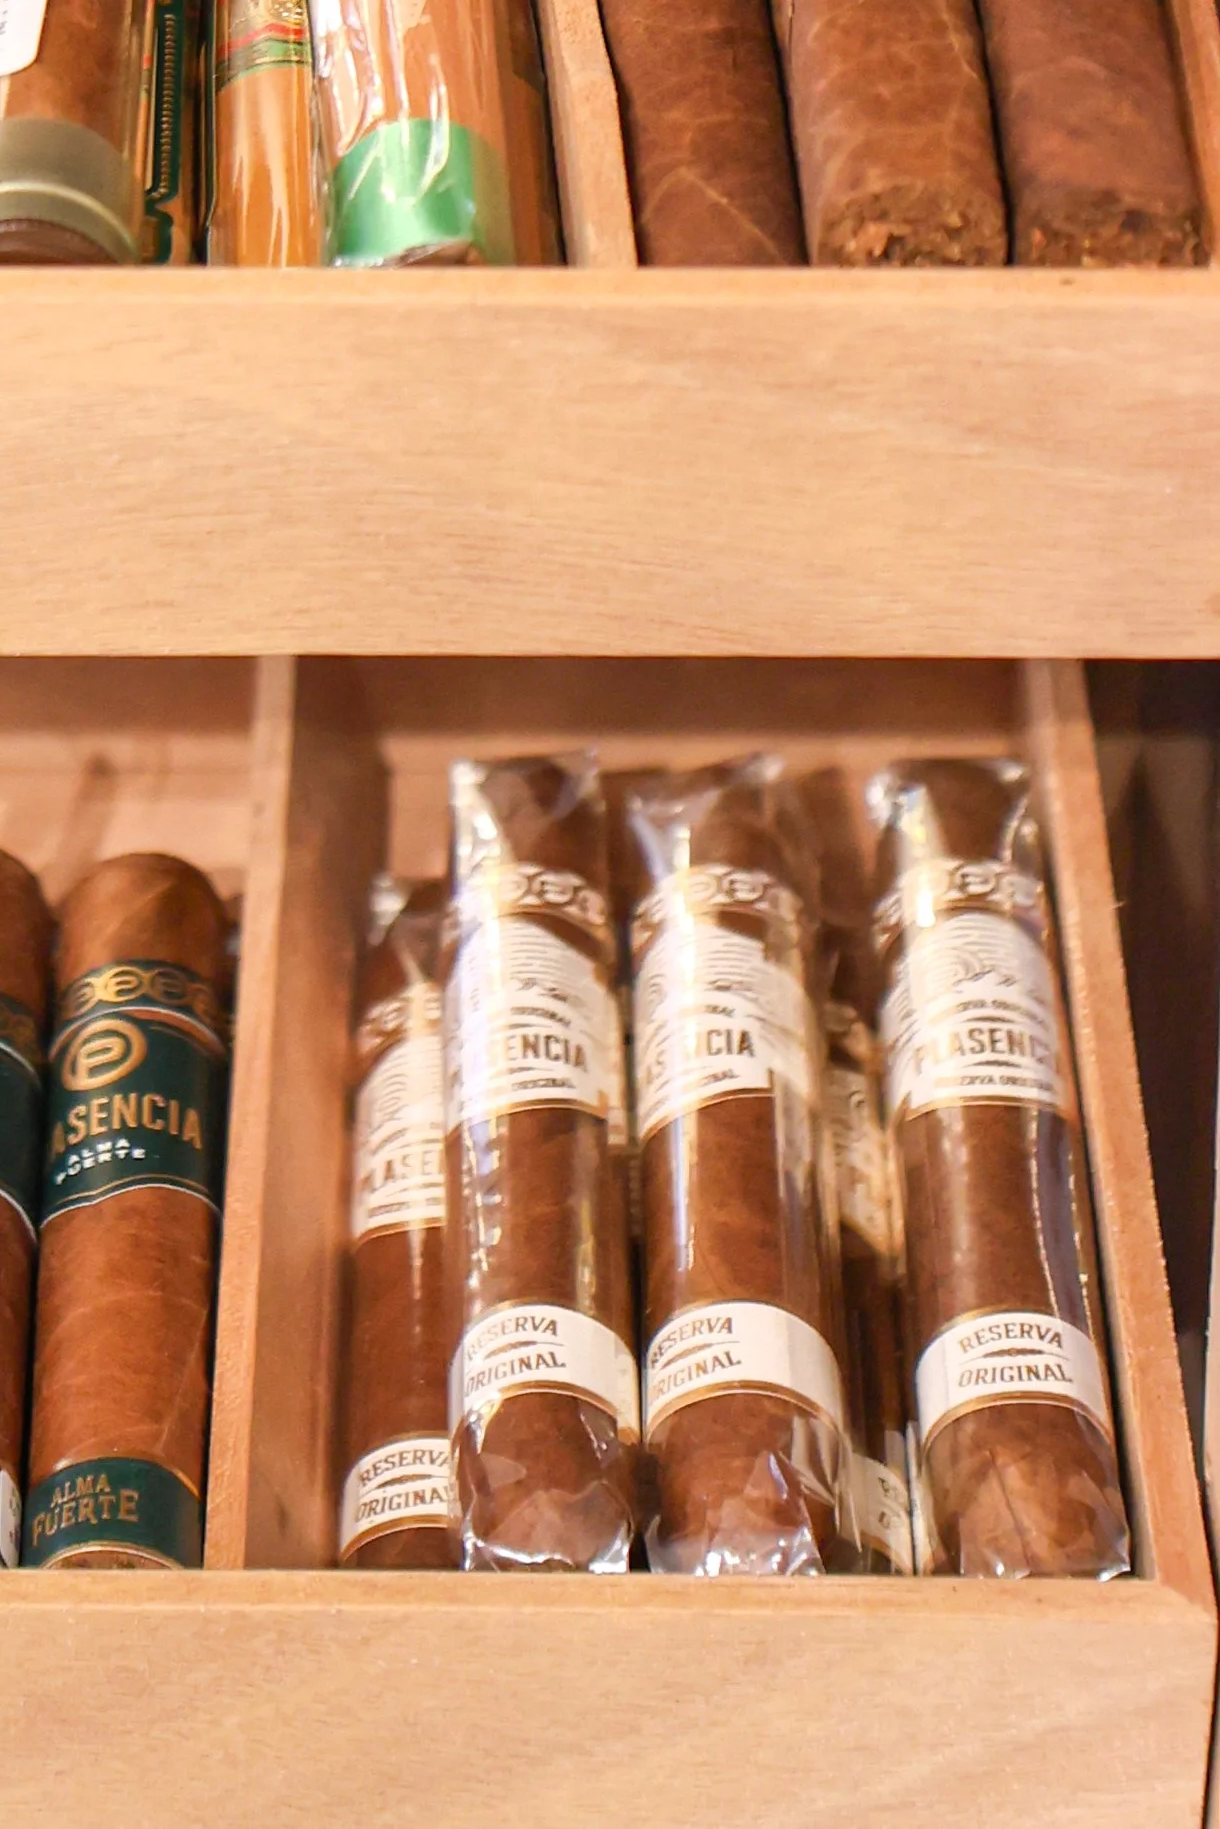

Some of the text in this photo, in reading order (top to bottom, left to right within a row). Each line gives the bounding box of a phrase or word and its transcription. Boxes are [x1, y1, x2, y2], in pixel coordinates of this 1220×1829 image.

[467, 1316, 558, 1361] RESERVA
[651, 1317, 733, 1369] RESERVA
[958, 1322, 1063, 1354] RESERVA
[465, 1351, 567, 1398] ORIGINAL
[958, 1363, 1073, 1388] ORIGINAL
[50, 1473, 111, 1508] ALMA
[32, 1488, 139, 1547] FUERTE
